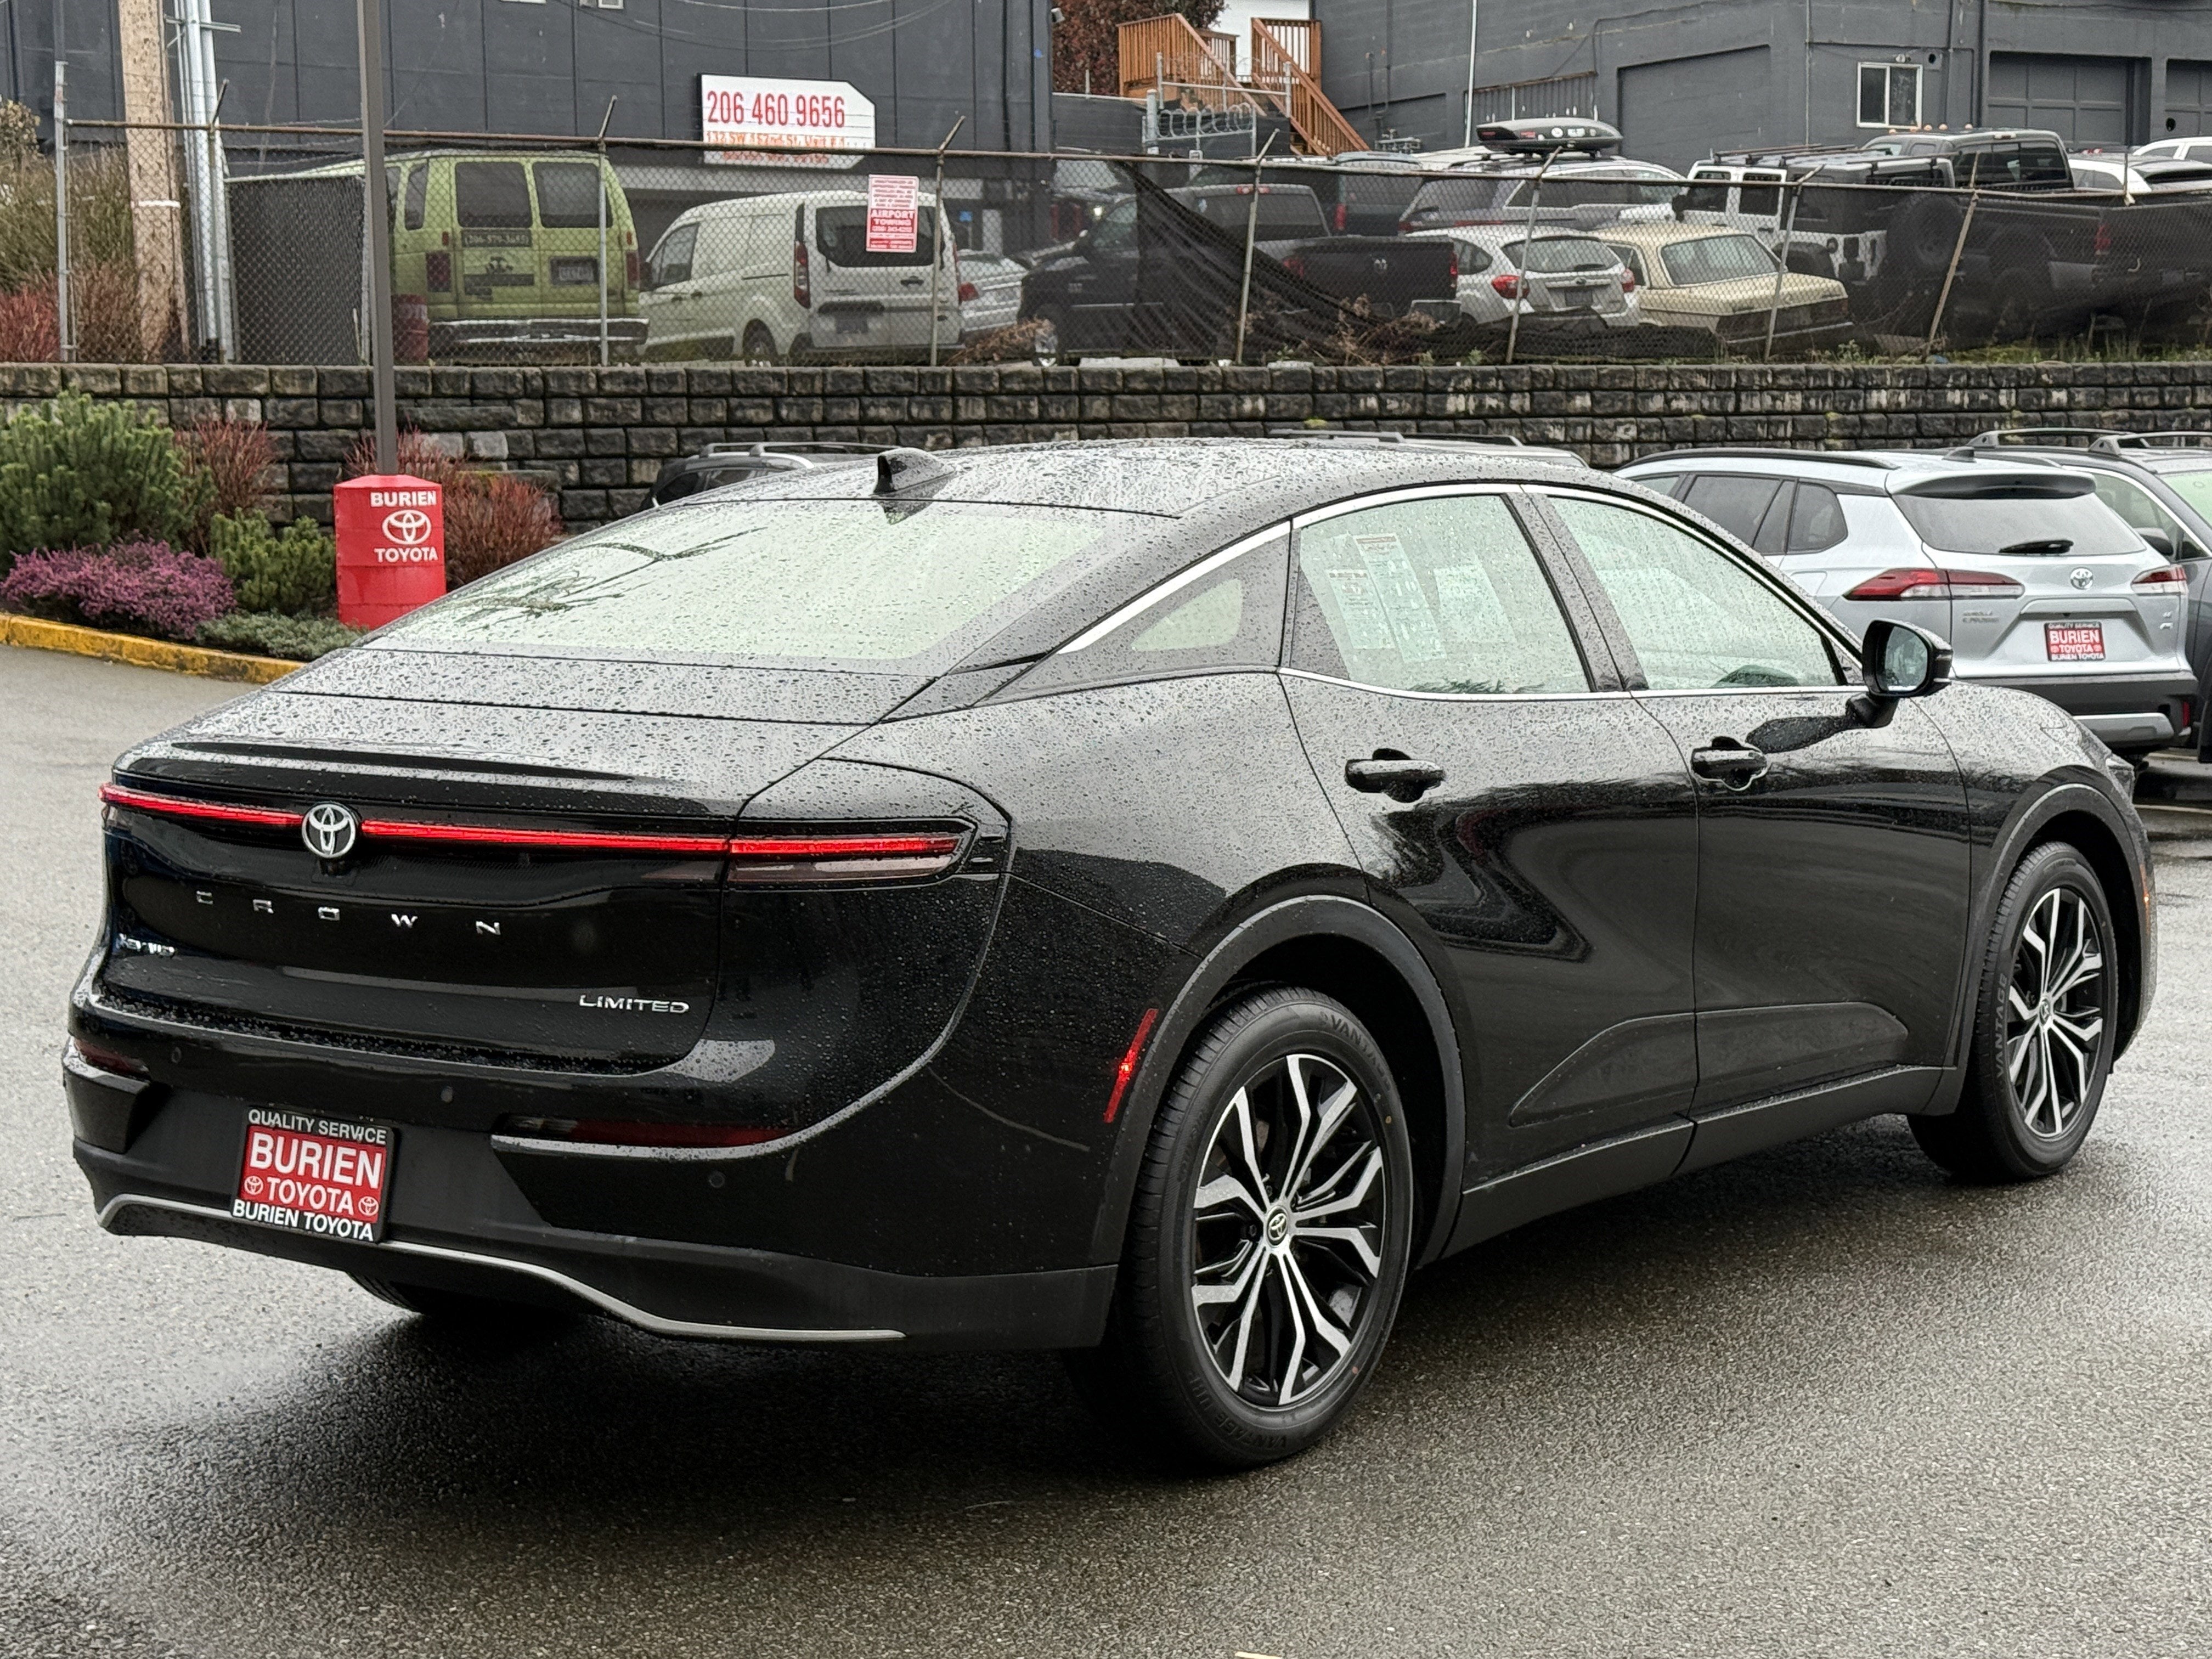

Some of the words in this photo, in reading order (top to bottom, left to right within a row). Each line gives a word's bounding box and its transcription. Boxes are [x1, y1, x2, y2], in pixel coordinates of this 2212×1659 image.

[707, 91, 744, 124] 206
[752, 93, 788, 126] 460
[796, 94, 845, 128] 9656
[871, 210, 914, 219] AIRPORT
[370, 490, 437, 507] BURIEN
[374, 547, 438, 563] TOYOTA
[2049, 629, 2100, 644] BURIEN
[2058, 644, 2094, 653] TOYOTA
[195, 890, 501, 935] CROWN
[579, 995, 690, 1013] LIMITED
[1995, 973, 2007, 1078] VANTAGE
[249, 1109, 315, 1133] QUALITY
[318, 1120, 387, 1145] SERVICE
[250, 1132, 382, 1189] BURIEN
[267, 1176, 354, 1216] TOYOTA
[233, 1199, 300, 1228] BURIEN
[303, 1211, 374, 1242] TOYOTA
